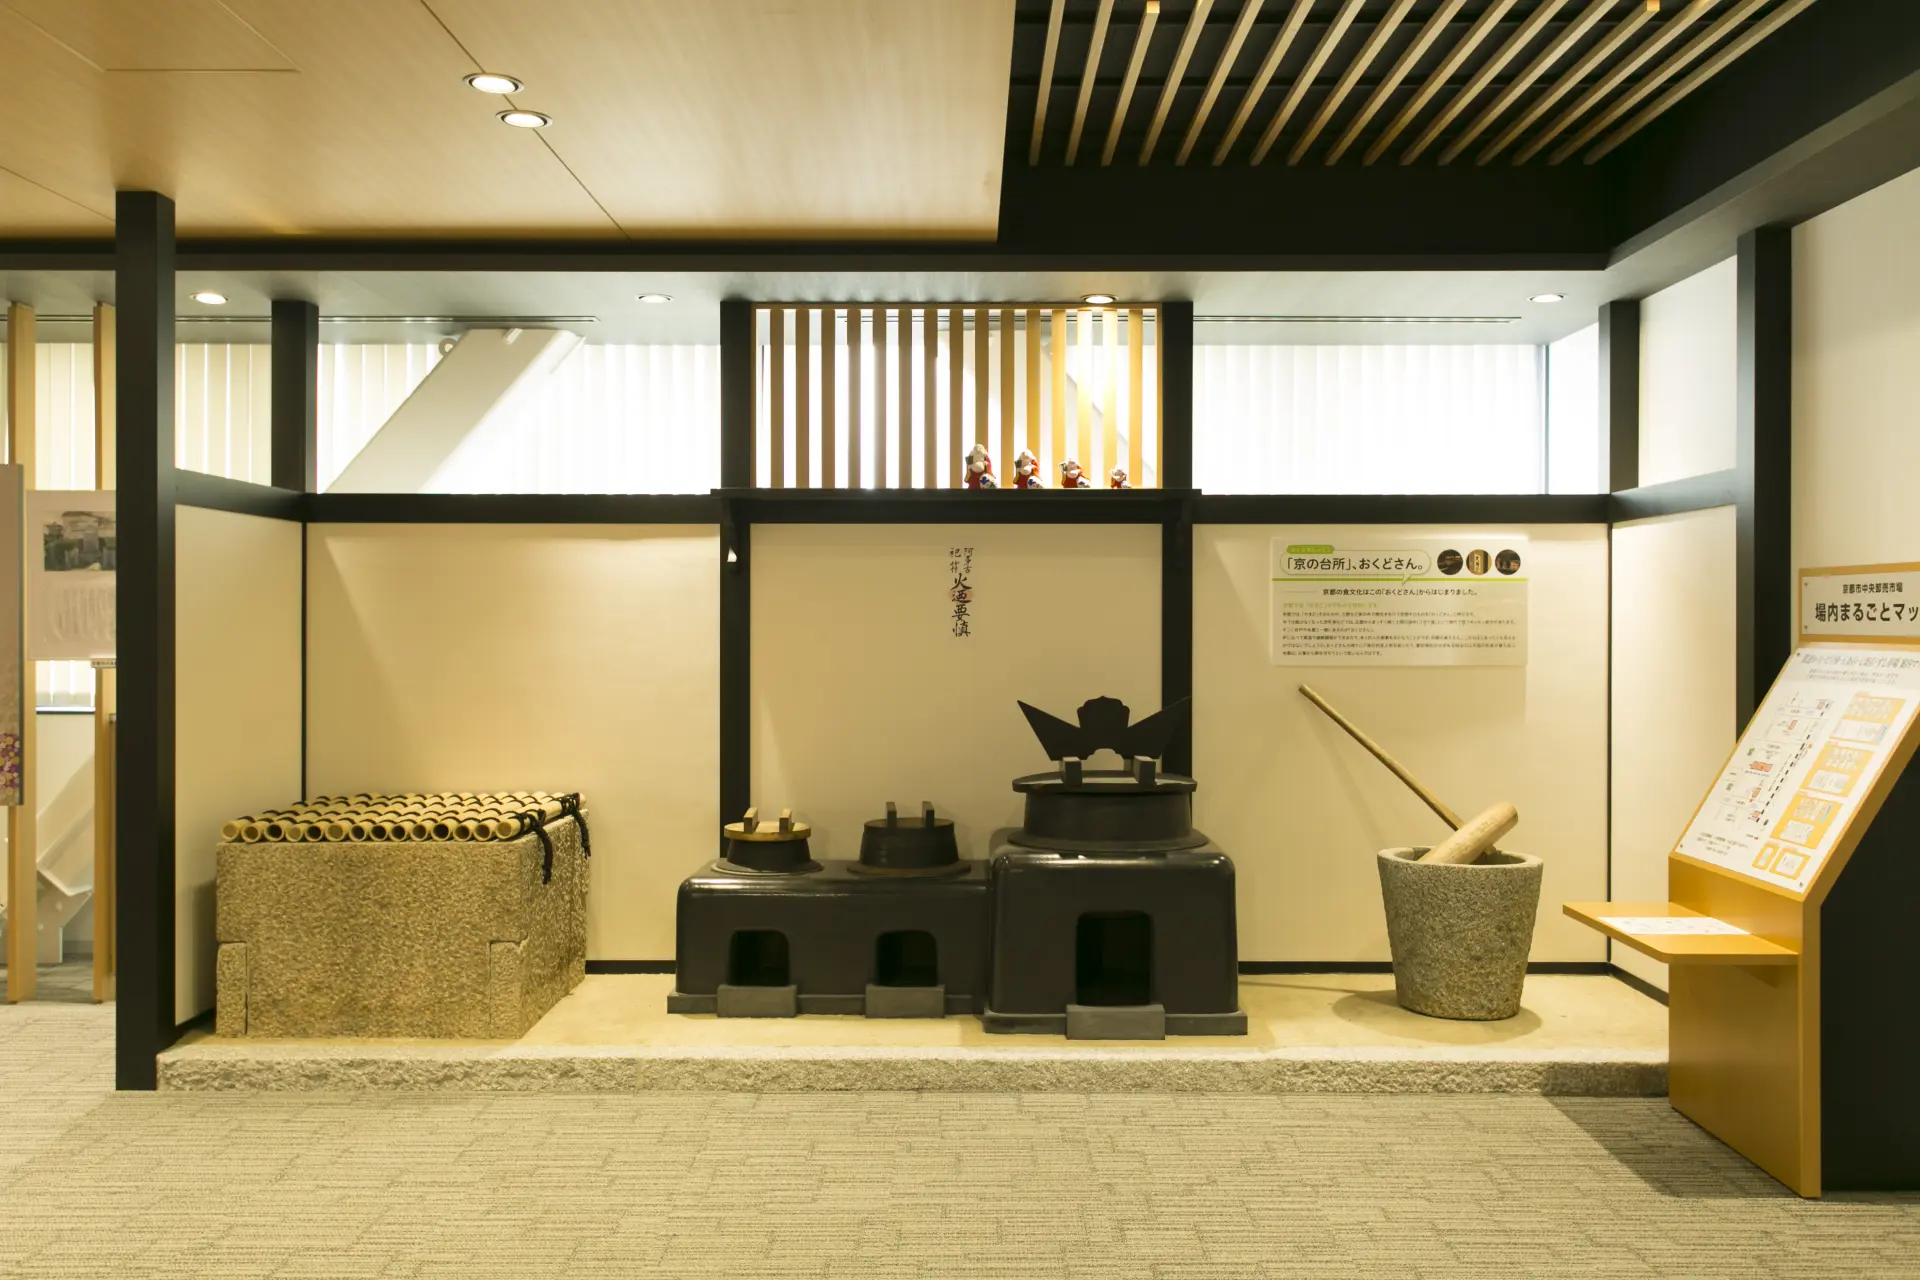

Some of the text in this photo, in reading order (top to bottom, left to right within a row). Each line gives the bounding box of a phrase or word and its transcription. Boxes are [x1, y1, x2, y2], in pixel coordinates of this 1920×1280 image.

[1287, 557, 1423, 571] 「京の台所」、おくどさん。
[1322, 588, 1478, 597] 京都の食文化はこの「おくどさん」からはじまりました。
[1842, 582, 1903, 594] 京都市中央卸売市場
